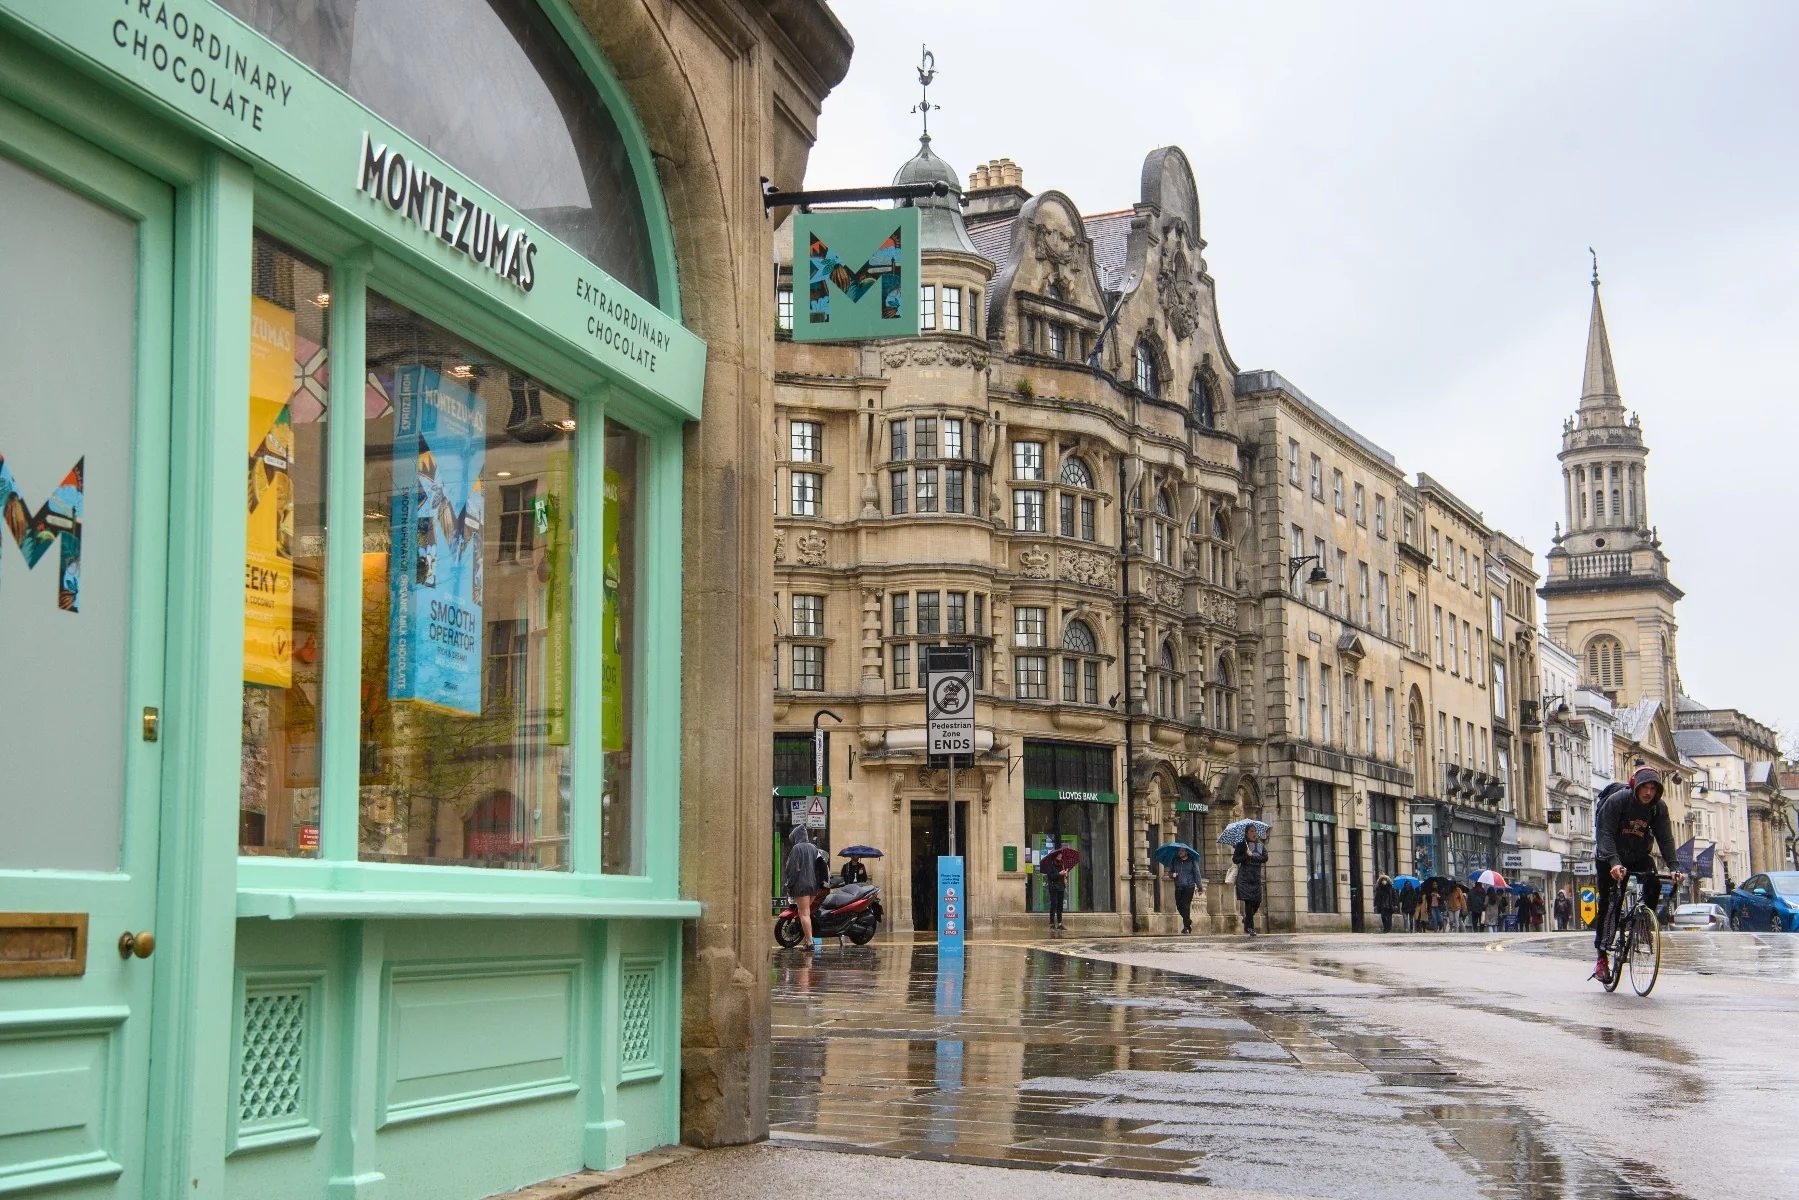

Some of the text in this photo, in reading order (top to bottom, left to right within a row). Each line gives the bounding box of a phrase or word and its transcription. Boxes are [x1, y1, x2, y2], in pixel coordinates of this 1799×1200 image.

[125, 0, 292, 106] RAORDINARY
[113, 19, 263, 132] CHOCOLATE
[357, 130, 538, 293] MONTEZUMA'S
[577, 277, 670, 353] EXTRAORDINARY
[587, 316, 657, 373] CHOCOLATE
[430, 600, 475, 634] SMOOTH
[429, 623, 475, 653] OPERATOR
[931, 722, 972, 730] Pedestrian
[942, 730, 961, 738] Zone
[934, 738, 970, 750] ENDS
[1059, 791, 1099, 801] LLOYDS BANK
